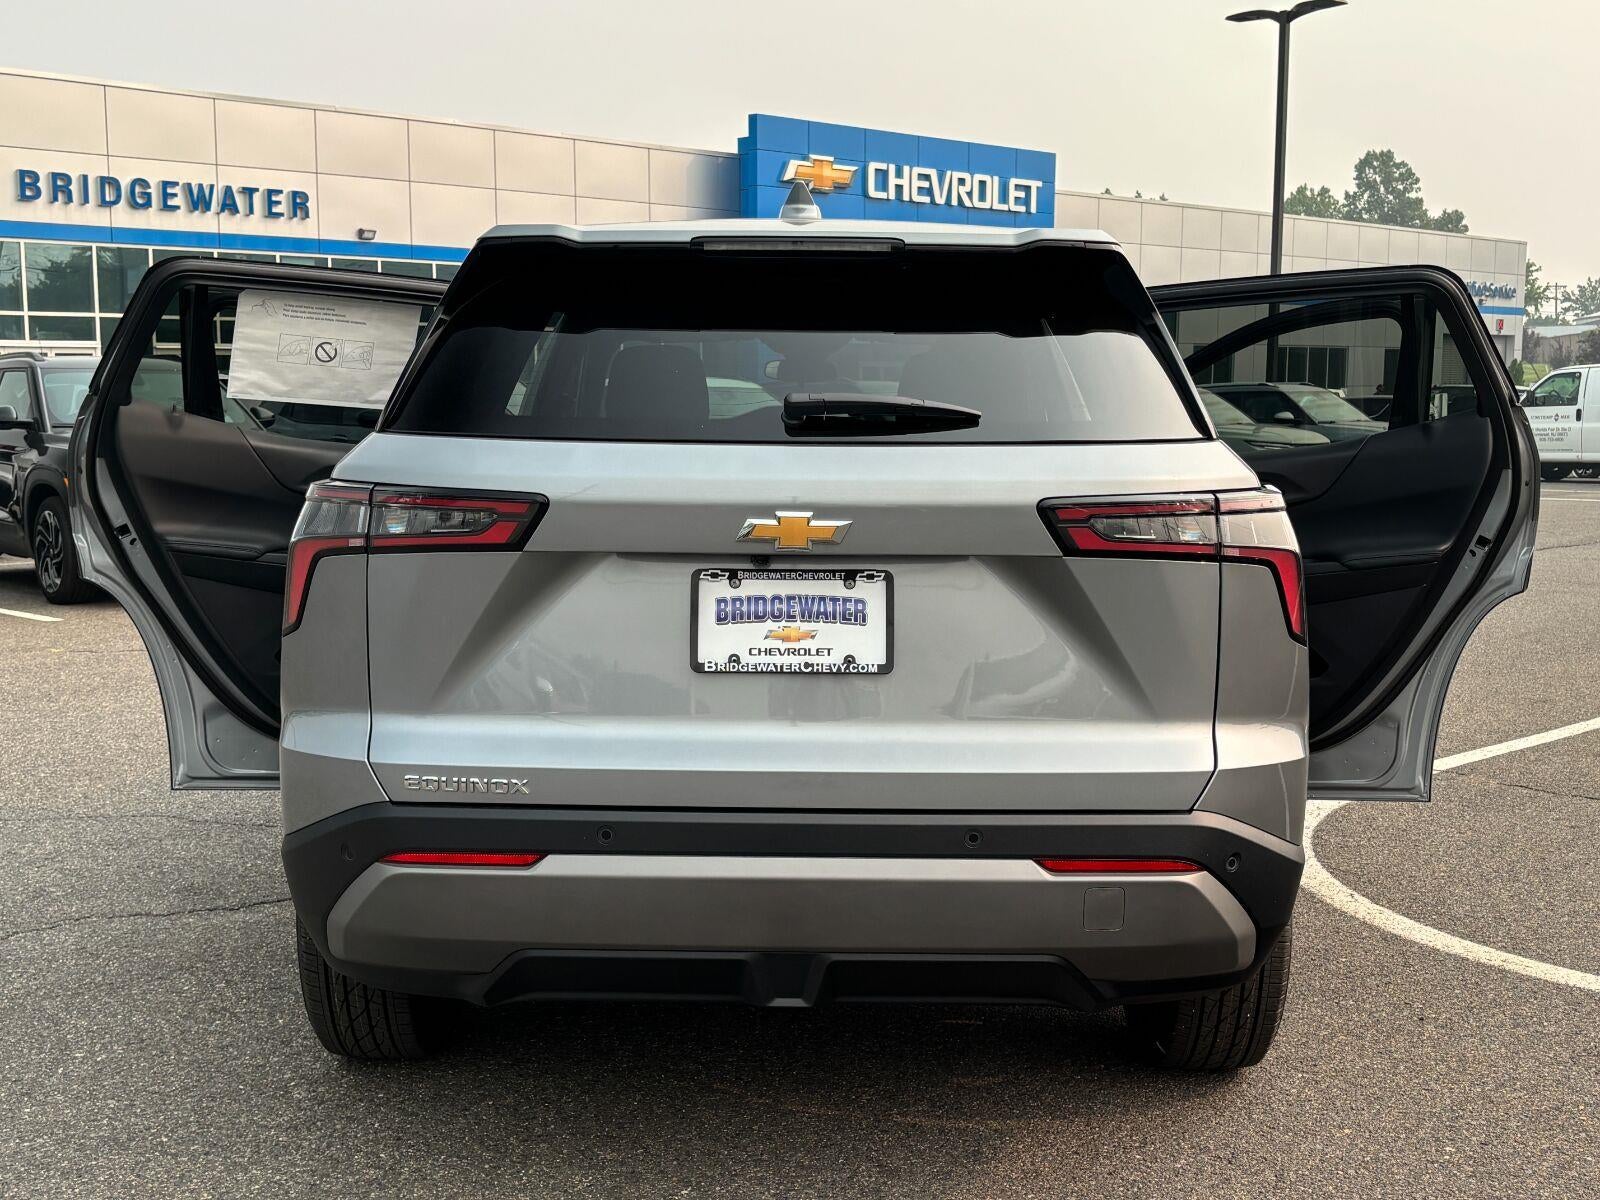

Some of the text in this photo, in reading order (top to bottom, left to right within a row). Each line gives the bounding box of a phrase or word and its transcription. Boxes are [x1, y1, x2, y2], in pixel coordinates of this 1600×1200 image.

[16, 168, 311, 220] BRIDGEWATER
[867, 161, 1042, 214] CHEVROLET
[1487, 282, 1517, 299] Service
[715, 594, 868, 626] BRIDGEWATER
[748, 647, 834, 657] CHEVROLET
[704, 658, 878, 673] BRIDGEWATERCHEVY.COM
[403, 774, 529, 794] EQUINOX
